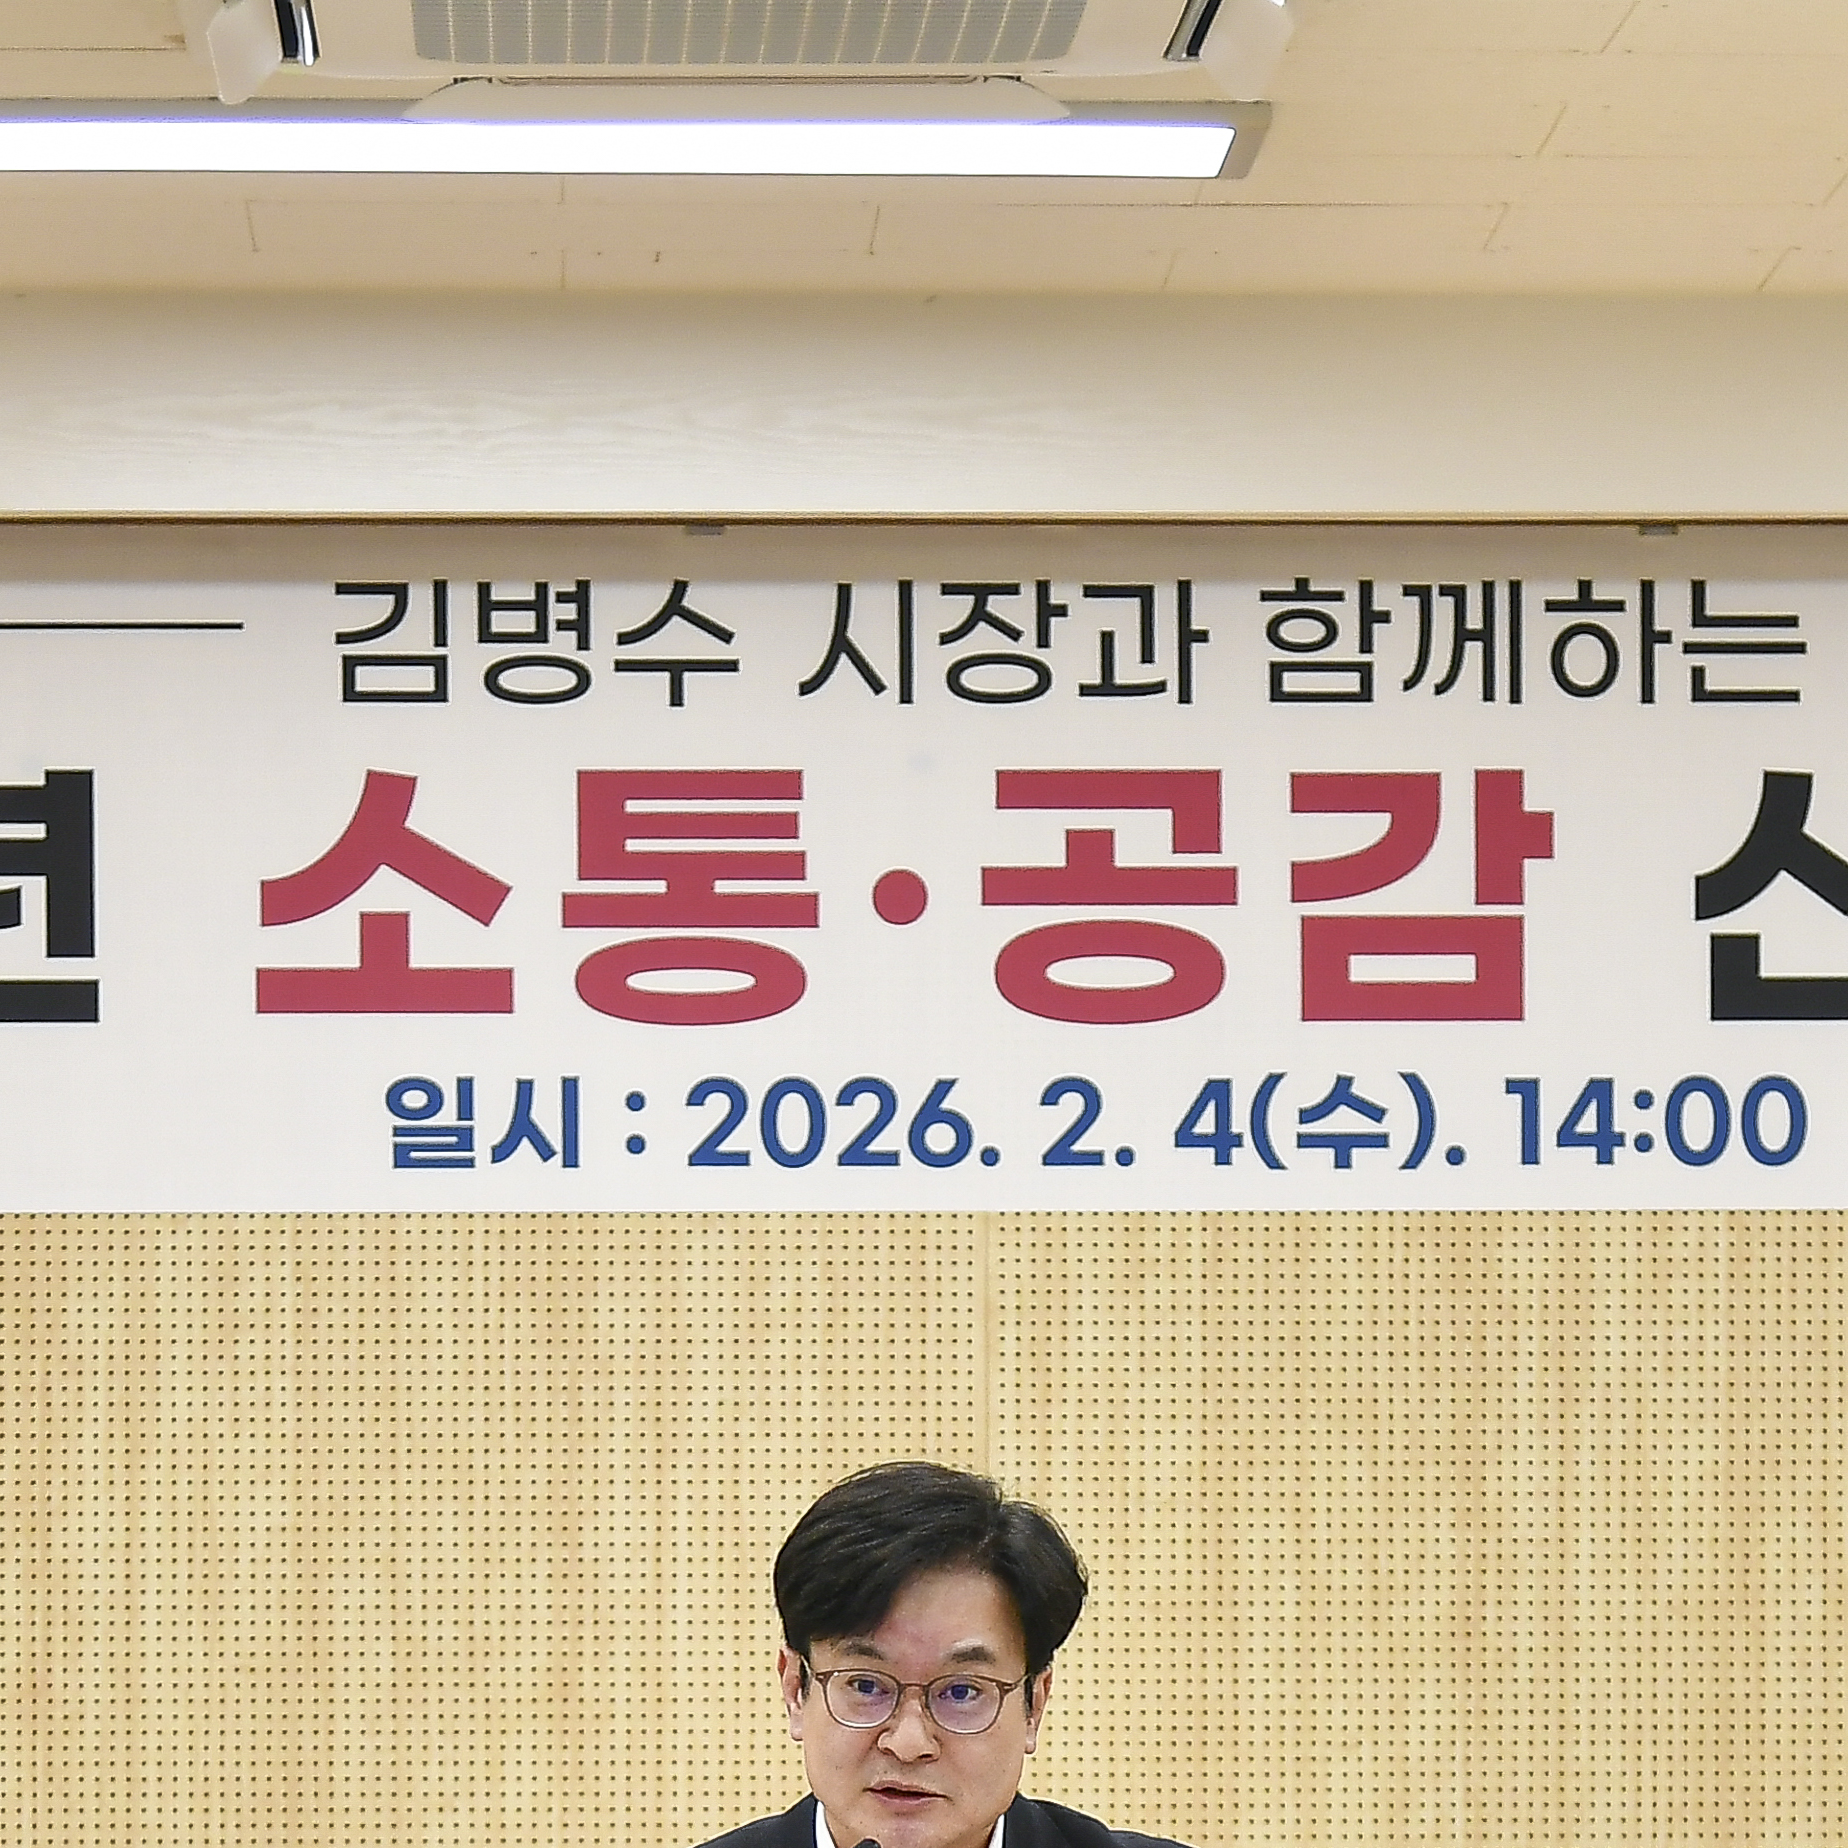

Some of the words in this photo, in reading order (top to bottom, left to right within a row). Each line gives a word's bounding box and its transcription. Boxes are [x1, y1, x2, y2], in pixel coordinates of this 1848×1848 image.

[335, 579, 739, 707] 김병수
[799, 579, 1209, 704] 시장과
[1260, 577, 1807, 705] 함께하는
[256, 769, 1554, 1026] 소통·공감
[386, 1076, 579, 1168] 일시
[686, 1077, 999, 1168] 2026.
[1040, 1077, 1133, 1167] 2.
[1175, 1072, 1465, 1170] 4(수).
[1506, 1076, 1807, 1167] 14:00
